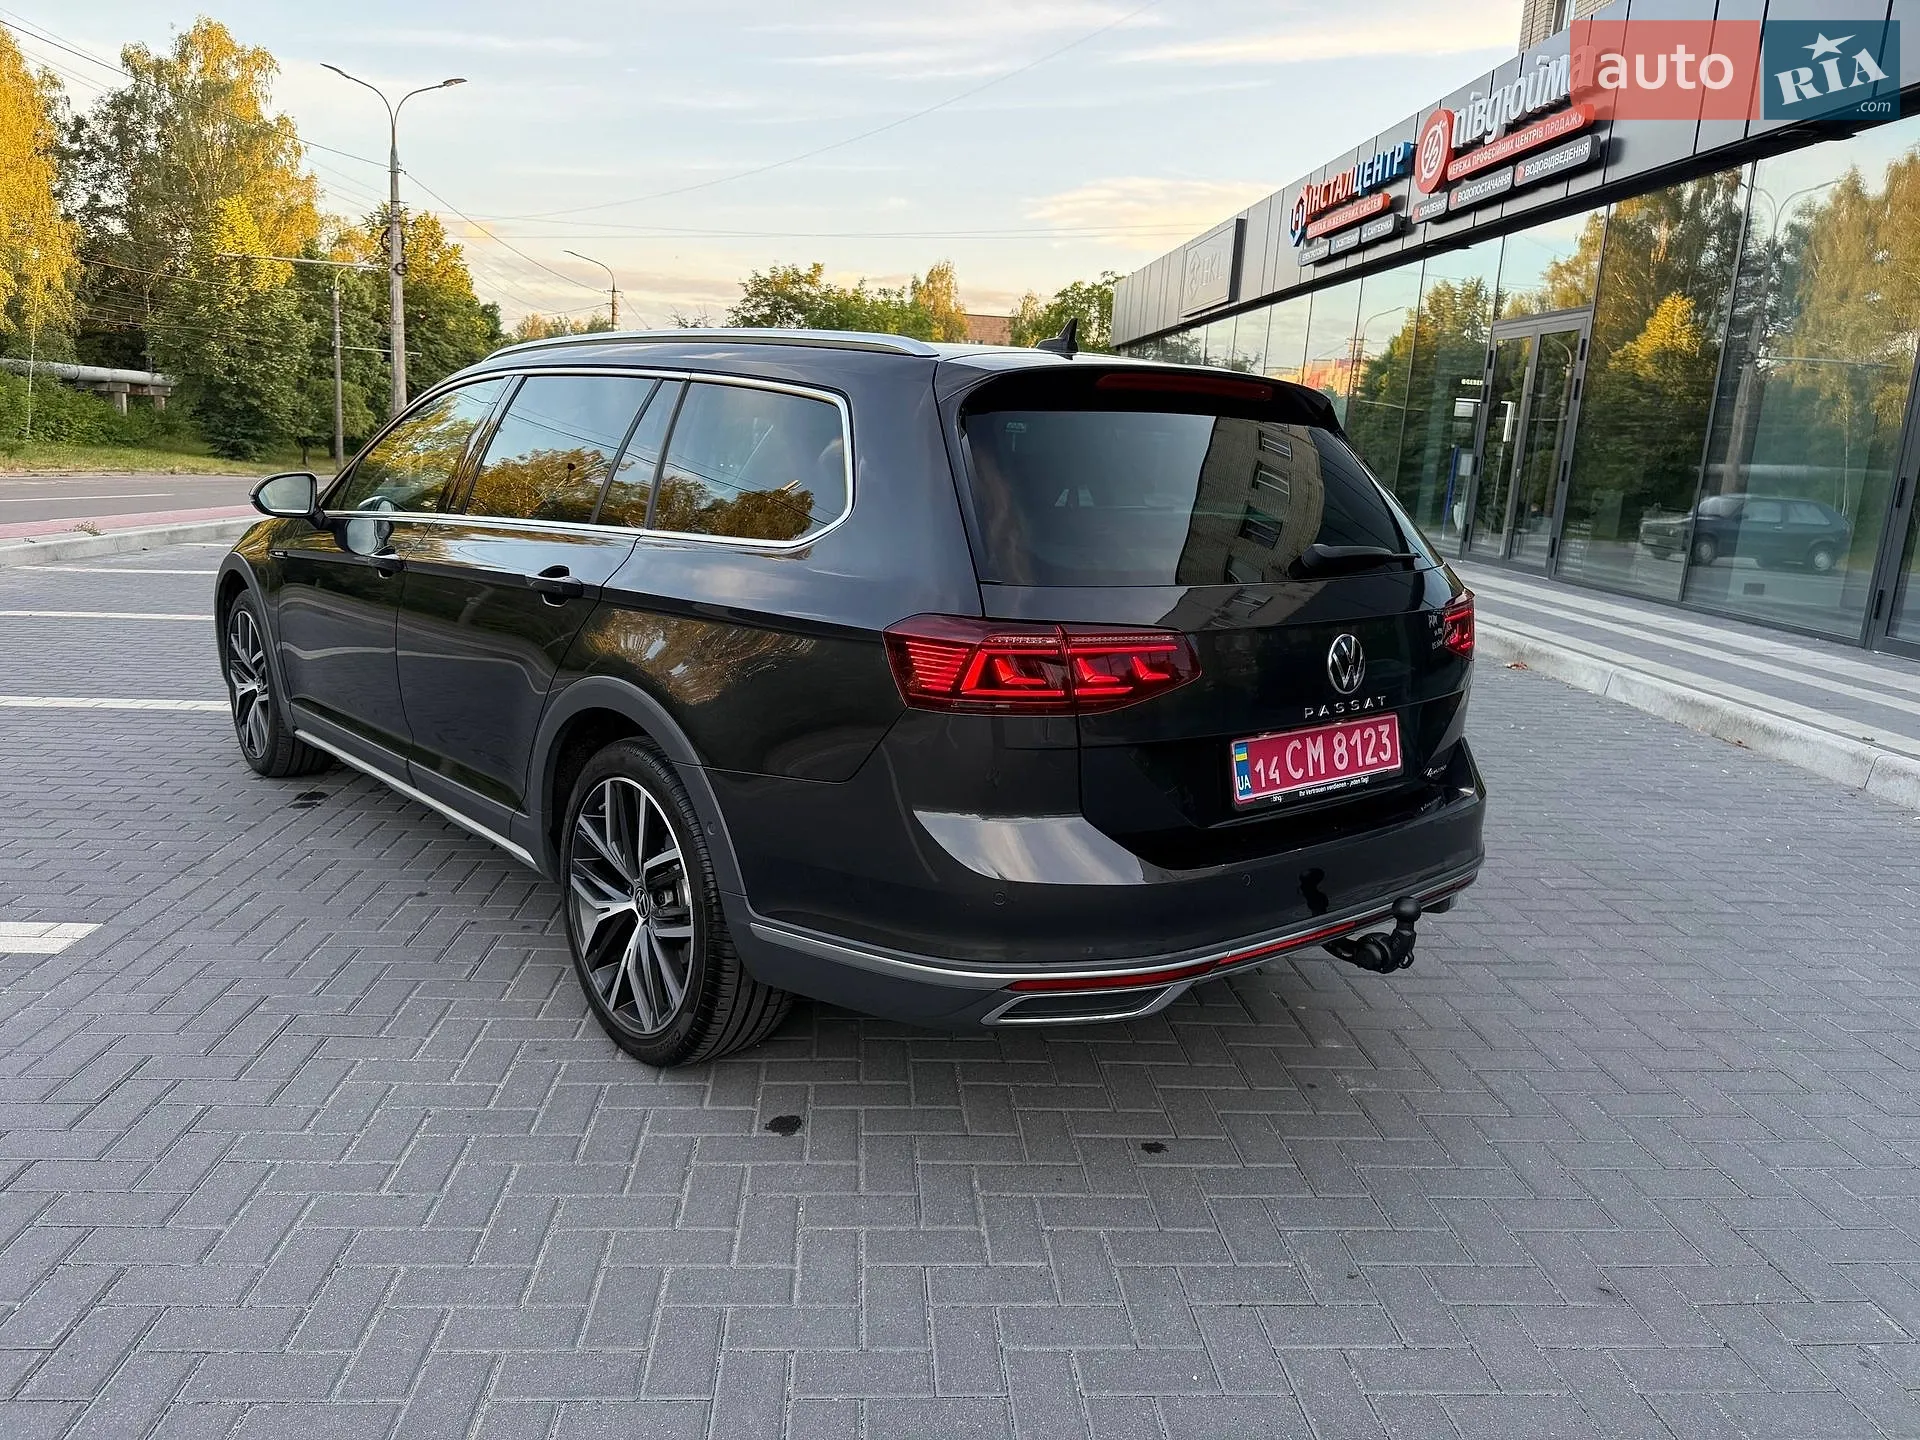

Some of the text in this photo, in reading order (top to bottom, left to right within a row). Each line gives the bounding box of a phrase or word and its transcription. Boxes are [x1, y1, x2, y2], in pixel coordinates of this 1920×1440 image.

[1515, 125, 1543, 148] ЦЕНТРІВ
[1524, 142, 1589, 177] ВОДОВІДВЕДЕННЯ
[1457, 172, 1511, 203] ВОДОПОСТАЧАННЯ
[1304, 696, 1386, 718] PASSAT
[1254, 724, 1391, 788] 14 CM 8123
[1237, 774, 1251, 790] UA
